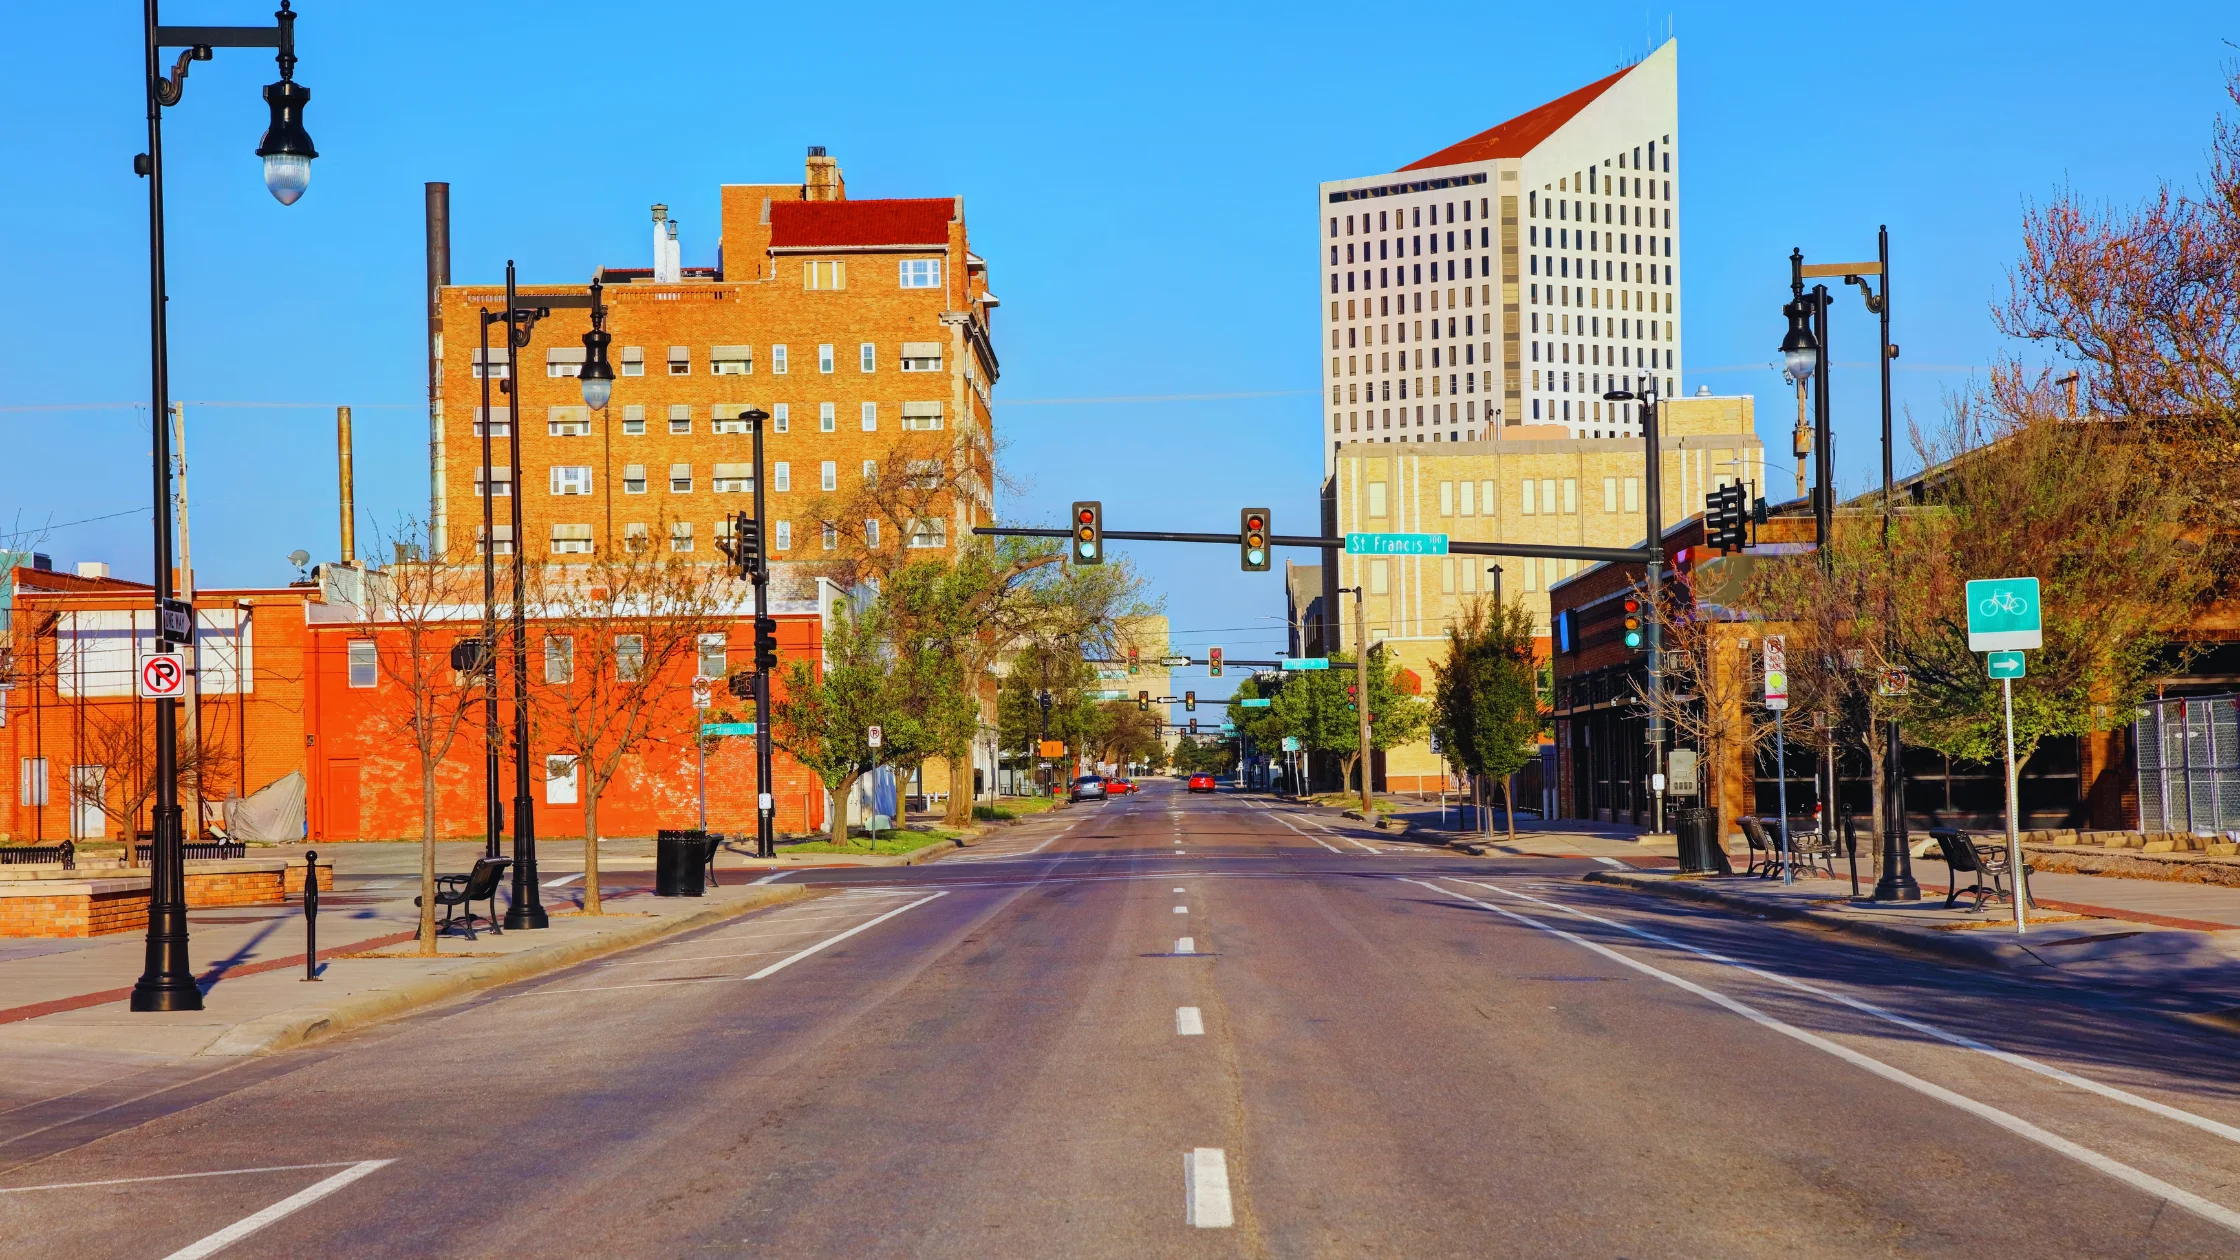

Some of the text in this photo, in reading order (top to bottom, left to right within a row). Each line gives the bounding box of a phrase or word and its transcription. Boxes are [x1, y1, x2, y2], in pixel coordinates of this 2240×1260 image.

[1352, 535, 1423, 552] St Francis
[1428, 535, 1442, 544] 300
[1432, 545, 1437, 553] N
